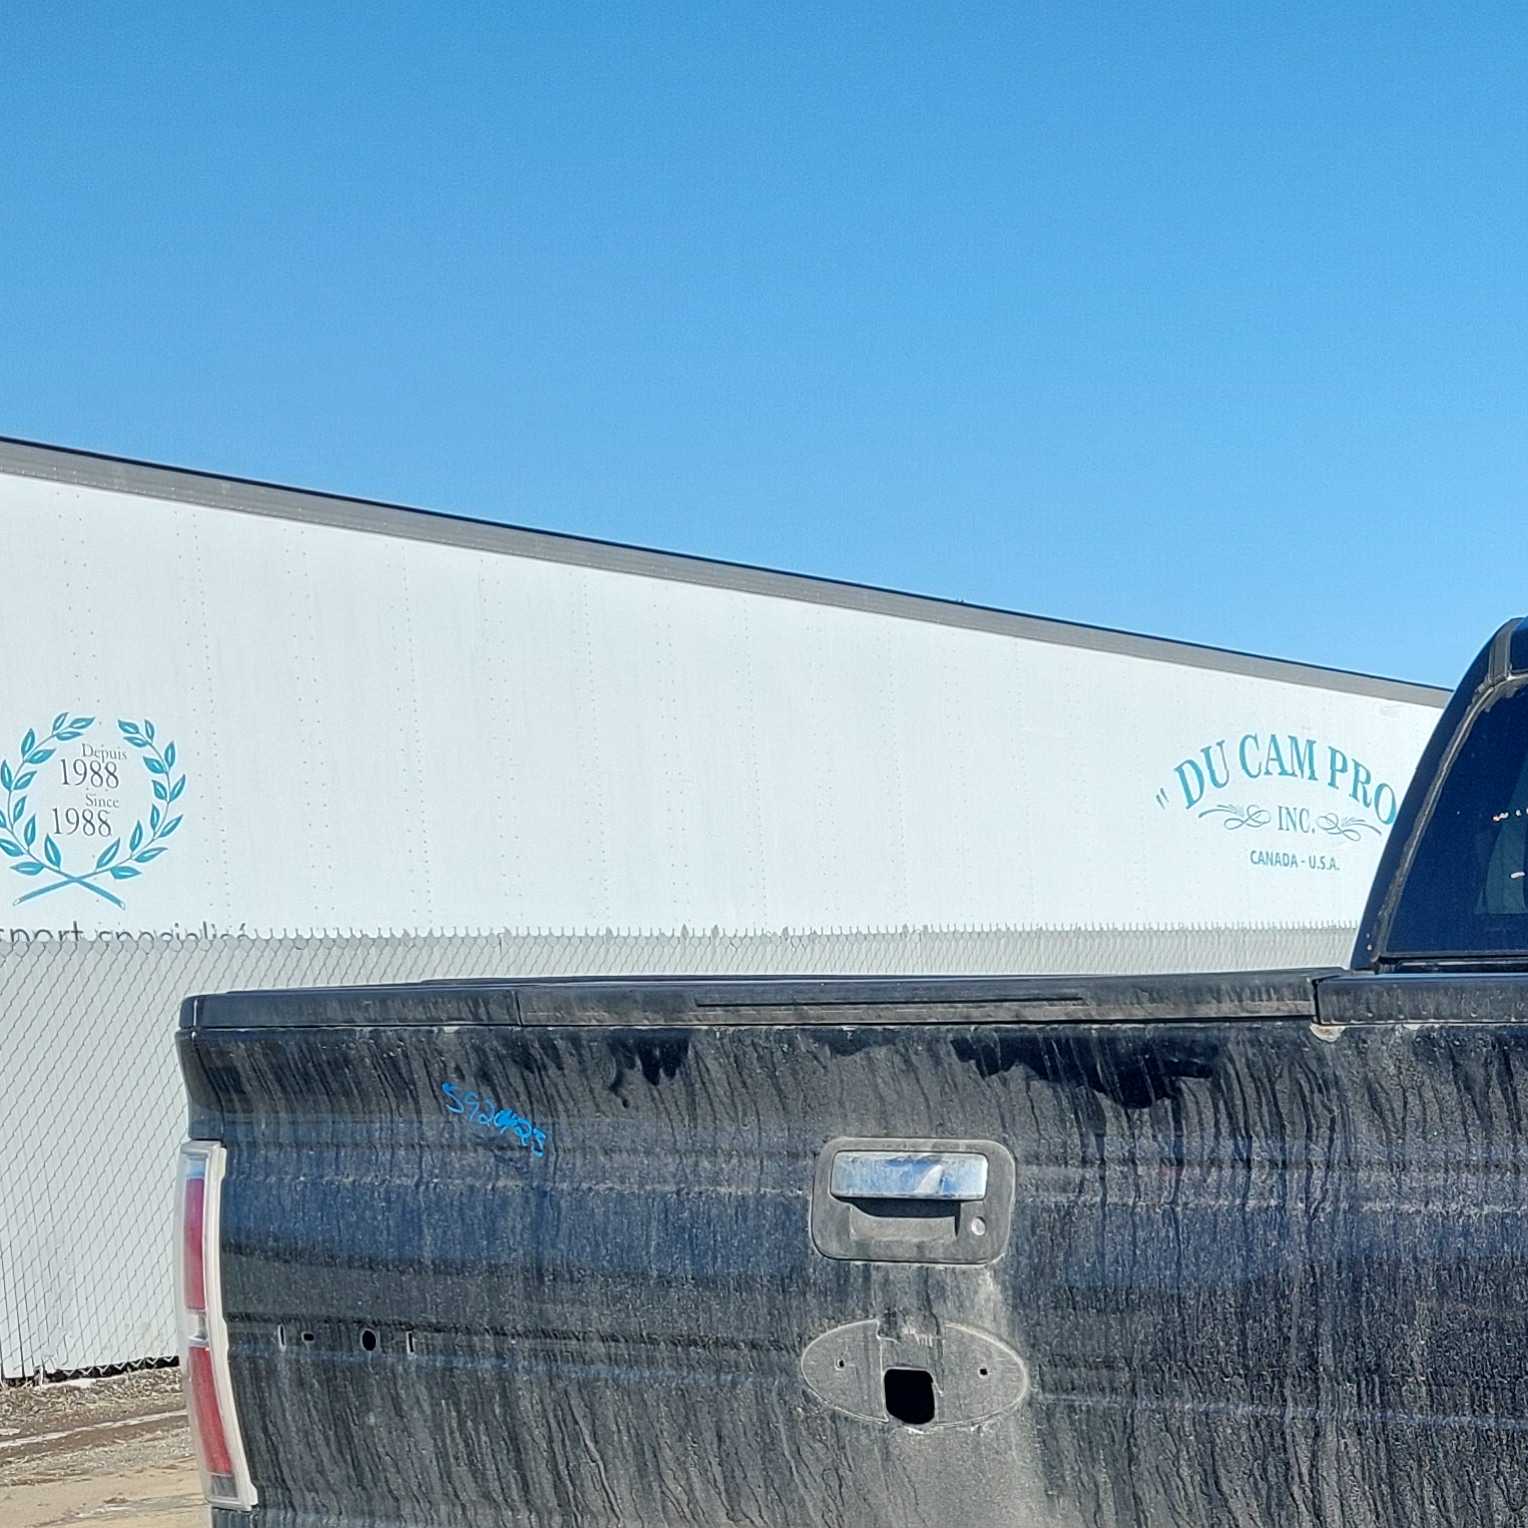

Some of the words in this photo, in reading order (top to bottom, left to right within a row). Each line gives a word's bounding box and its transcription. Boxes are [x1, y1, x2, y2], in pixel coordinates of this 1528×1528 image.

[81, 743, 128, 763] Depuis
[60, 758, 120, 789] 1988
[1239, 732, 1319, 781] CAM
[1327, 745, 1397, 826] PRO
[85, 793, 120, 808] Since
[52, 807, 112, 837] 1988
[1277, 805, 1316, 834] INC.
[1249, 850, 1299, 869] CANADA
[1308, 855, 1341, 871] U.S.A.
